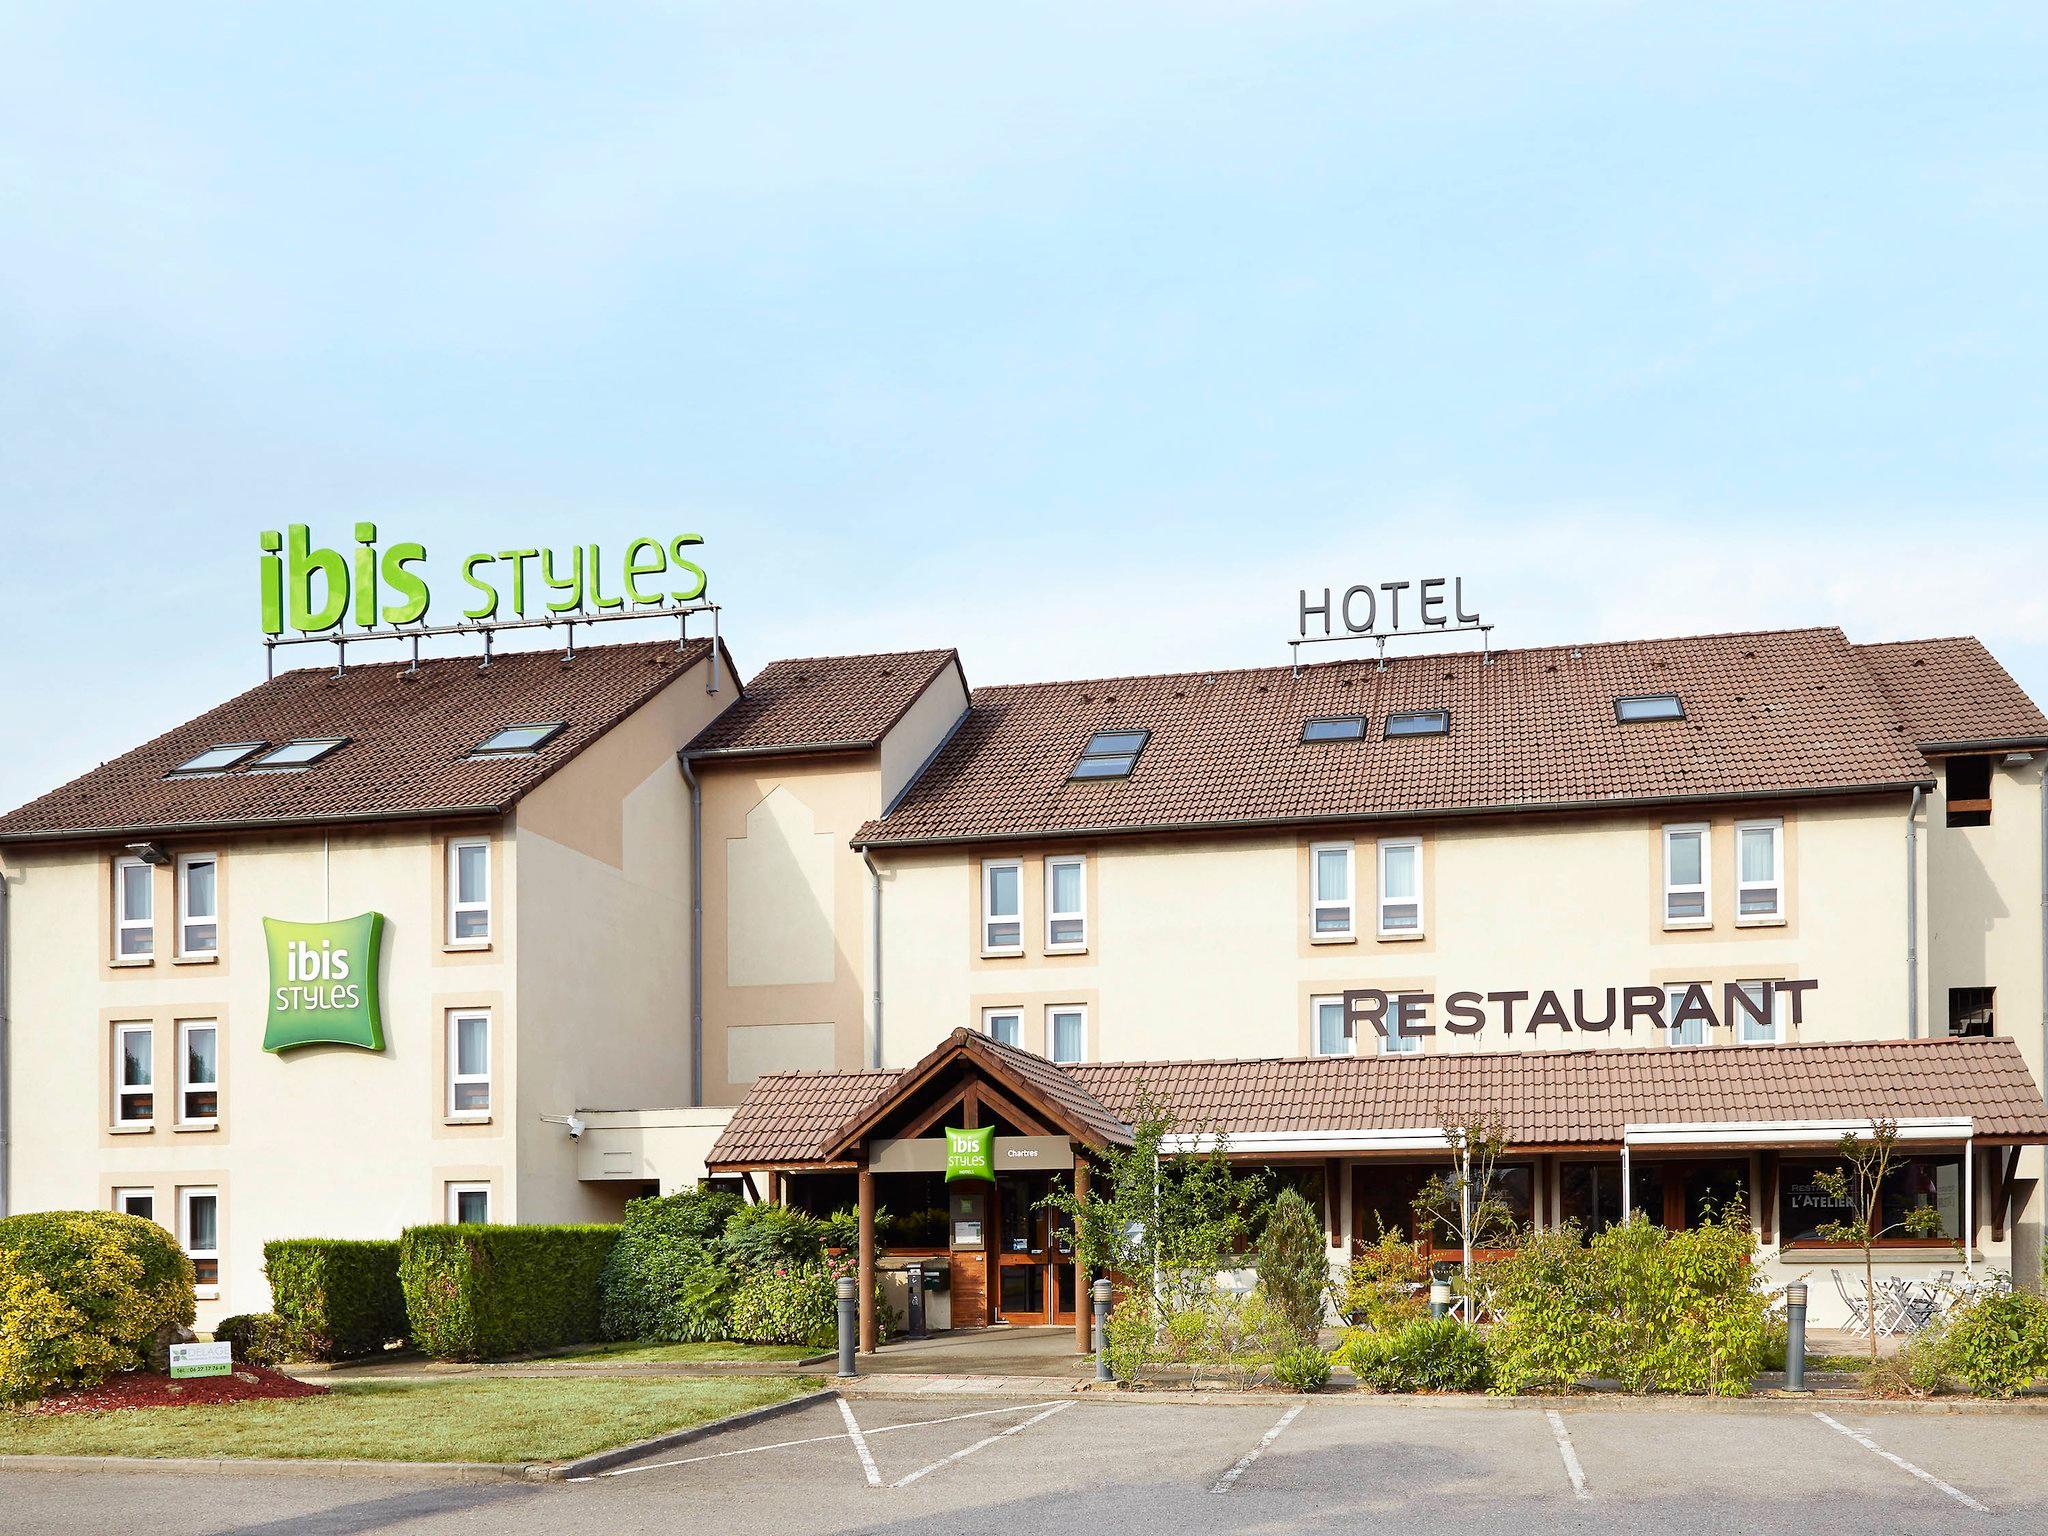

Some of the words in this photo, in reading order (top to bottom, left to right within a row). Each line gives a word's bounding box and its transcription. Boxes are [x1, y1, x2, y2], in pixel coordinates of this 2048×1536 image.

[259, 521, 430, 634] ibis
[1300, 577, 1480, 636] HOTEL
[287, 939, 349, 981] ibis
[1343, 979, 1819, 1039] RESTAURANT
[952, 1135, 980, 1153] ibis
[1007, 1149, 1039, 1158] Chartres
[1791, 1194, 1855, 1209] L'ATELIER
